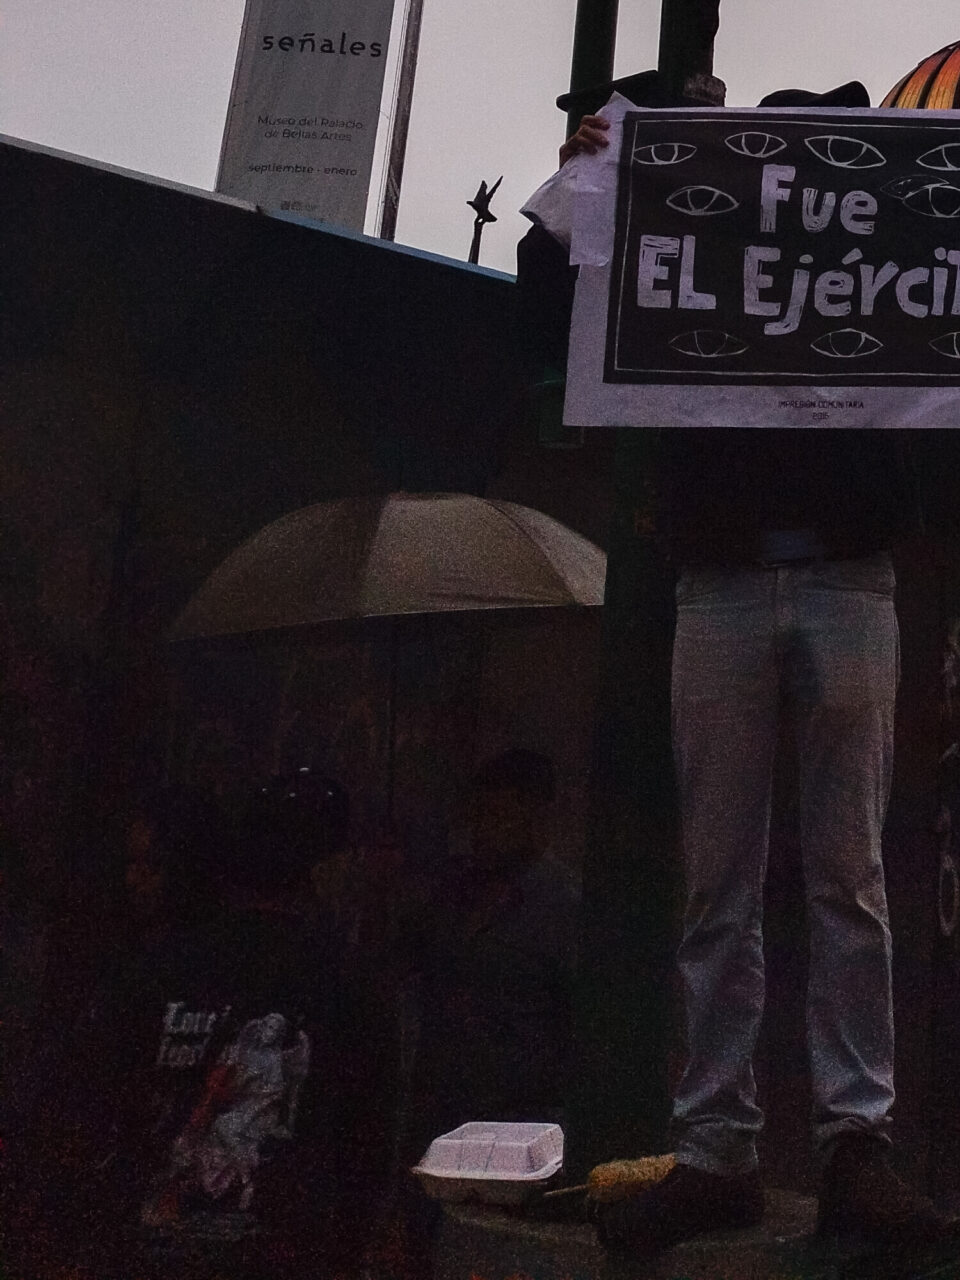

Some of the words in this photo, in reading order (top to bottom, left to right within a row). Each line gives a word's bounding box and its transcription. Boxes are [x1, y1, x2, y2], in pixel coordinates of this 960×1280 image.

[262, 32, 382, 58] señales
[257, 115, 296, 127] Museo
[299, 117, 318, 127] del
[321, 118, 364, 130] Palacio
[264, 128, 279, 138] de
[282, 128, 318, 140] Bellas
[321, 131, 353, 142] Artes
[248, 162, 314, 175] septiembre
[324, 166, 358, 177] enero
[760, 164, 878, 235] Fue
